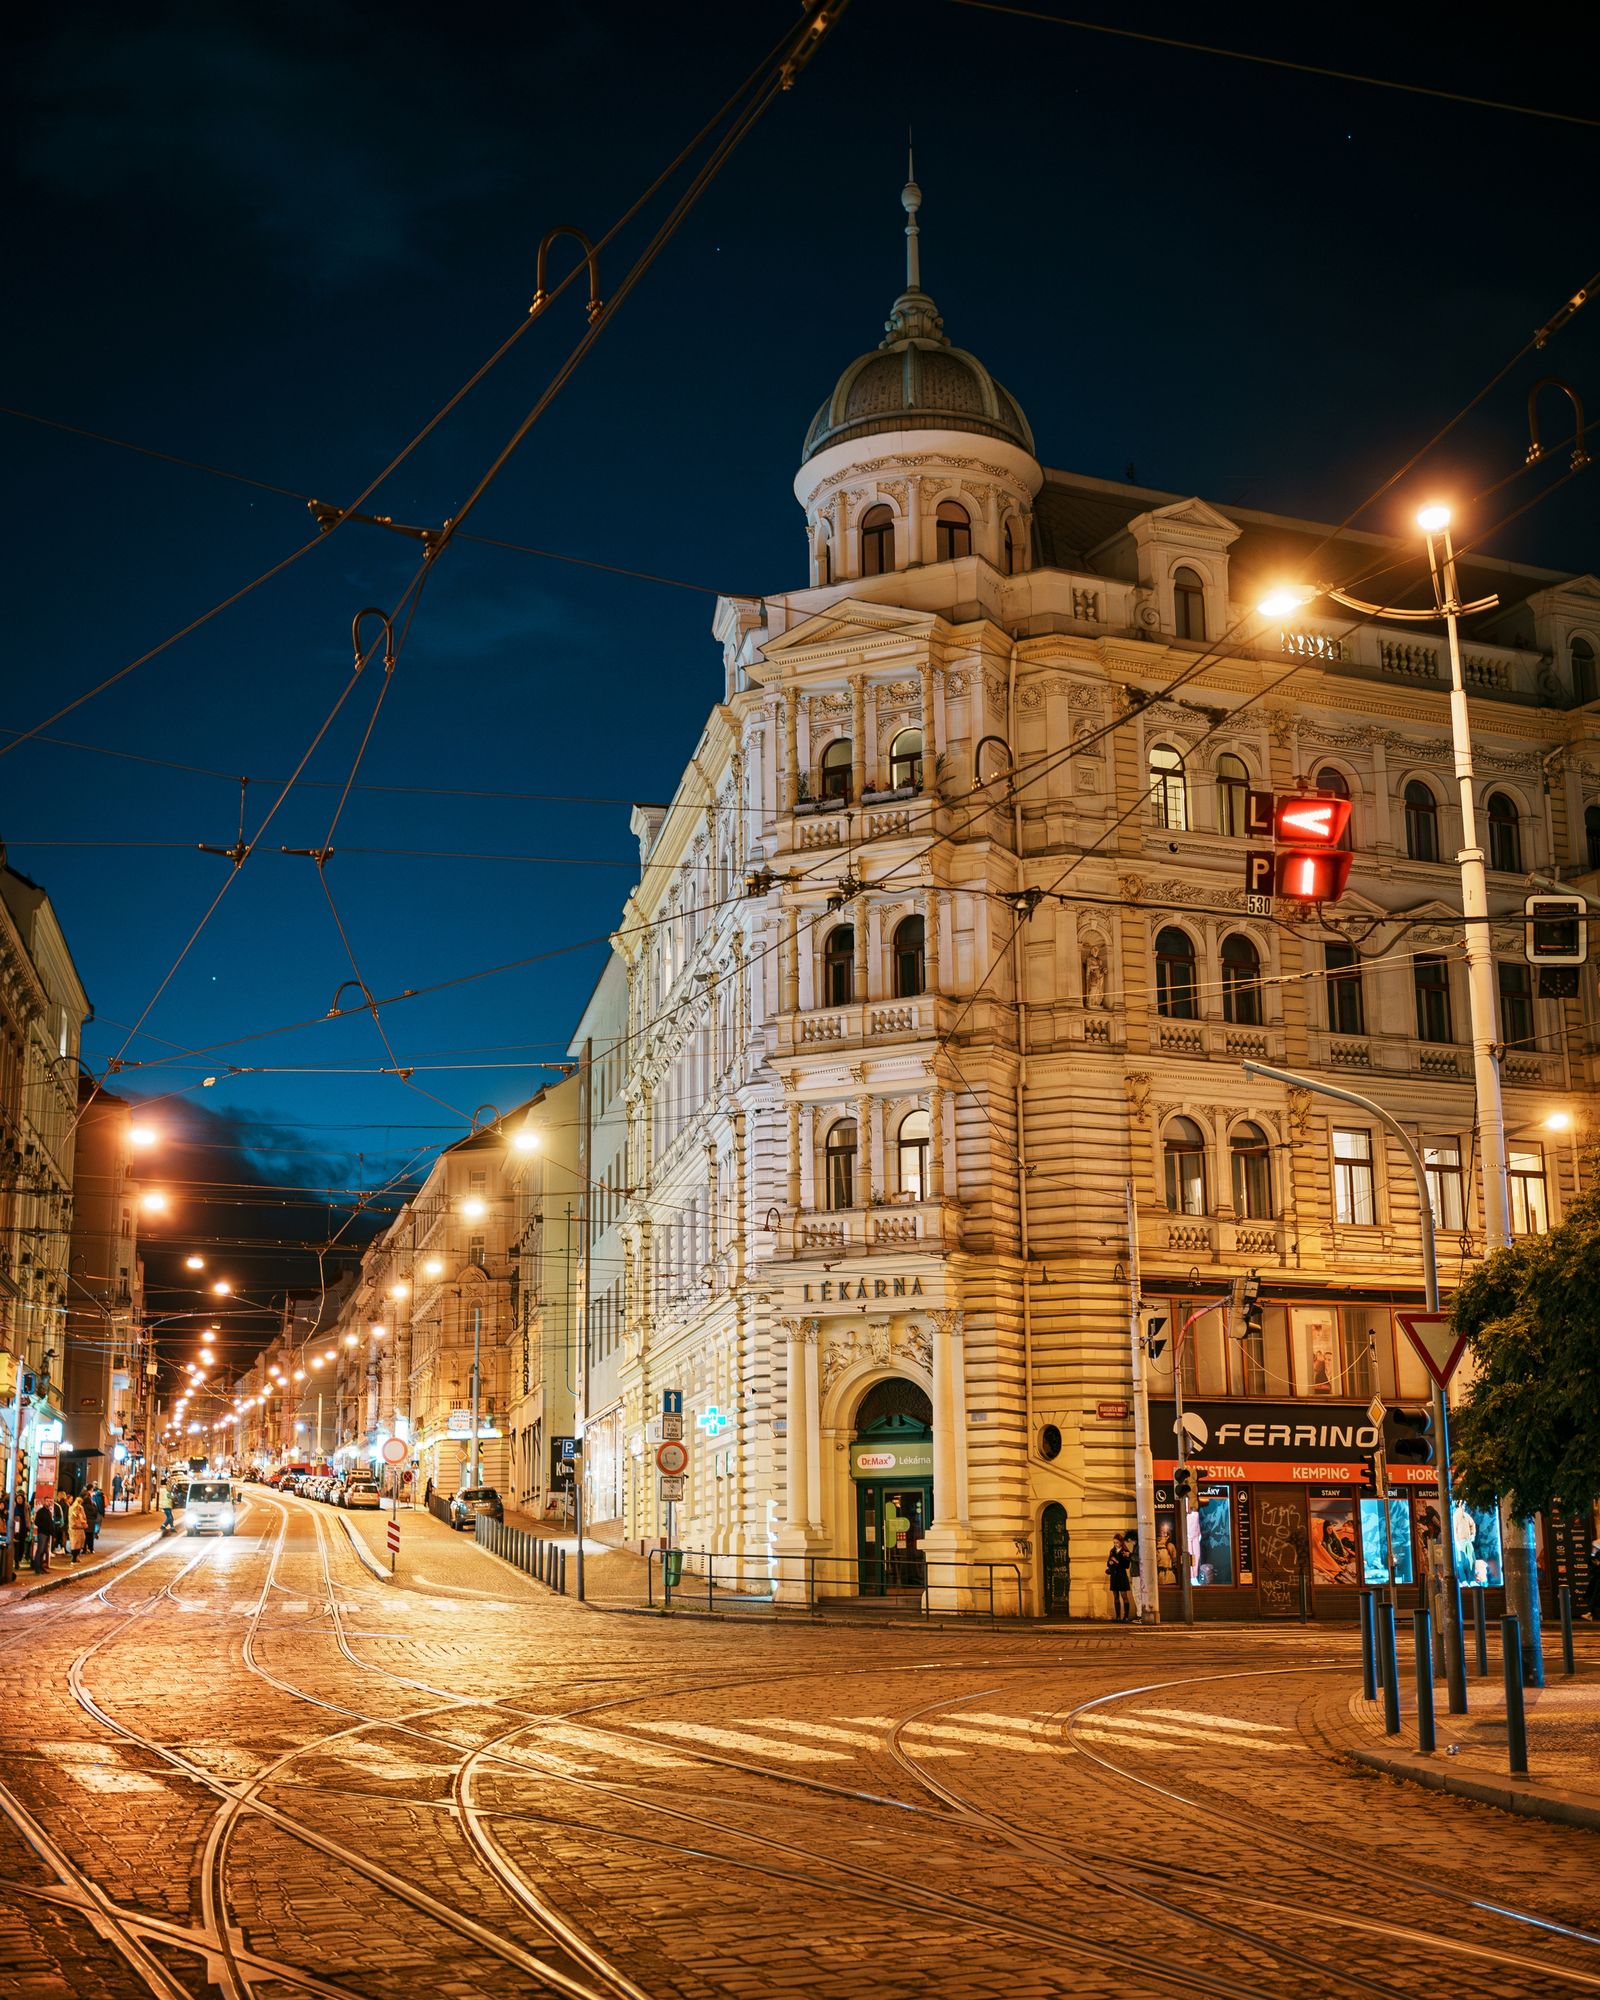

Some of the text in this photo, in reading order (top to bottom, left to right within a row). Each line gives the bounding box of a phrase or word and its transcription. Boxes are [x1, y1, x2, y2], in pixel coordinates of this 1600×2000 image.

[1251, 796, 1268, 828] L
[1252, 858, 1270, 889] P
[1249, 896, 1271, 914] 530
[804, 1277, 923, 1302] LÉKÁRNA
[1215, 1424, 1379, 1448] FERRINO
[1292, 1467, 1350, 1480] KEMPING
